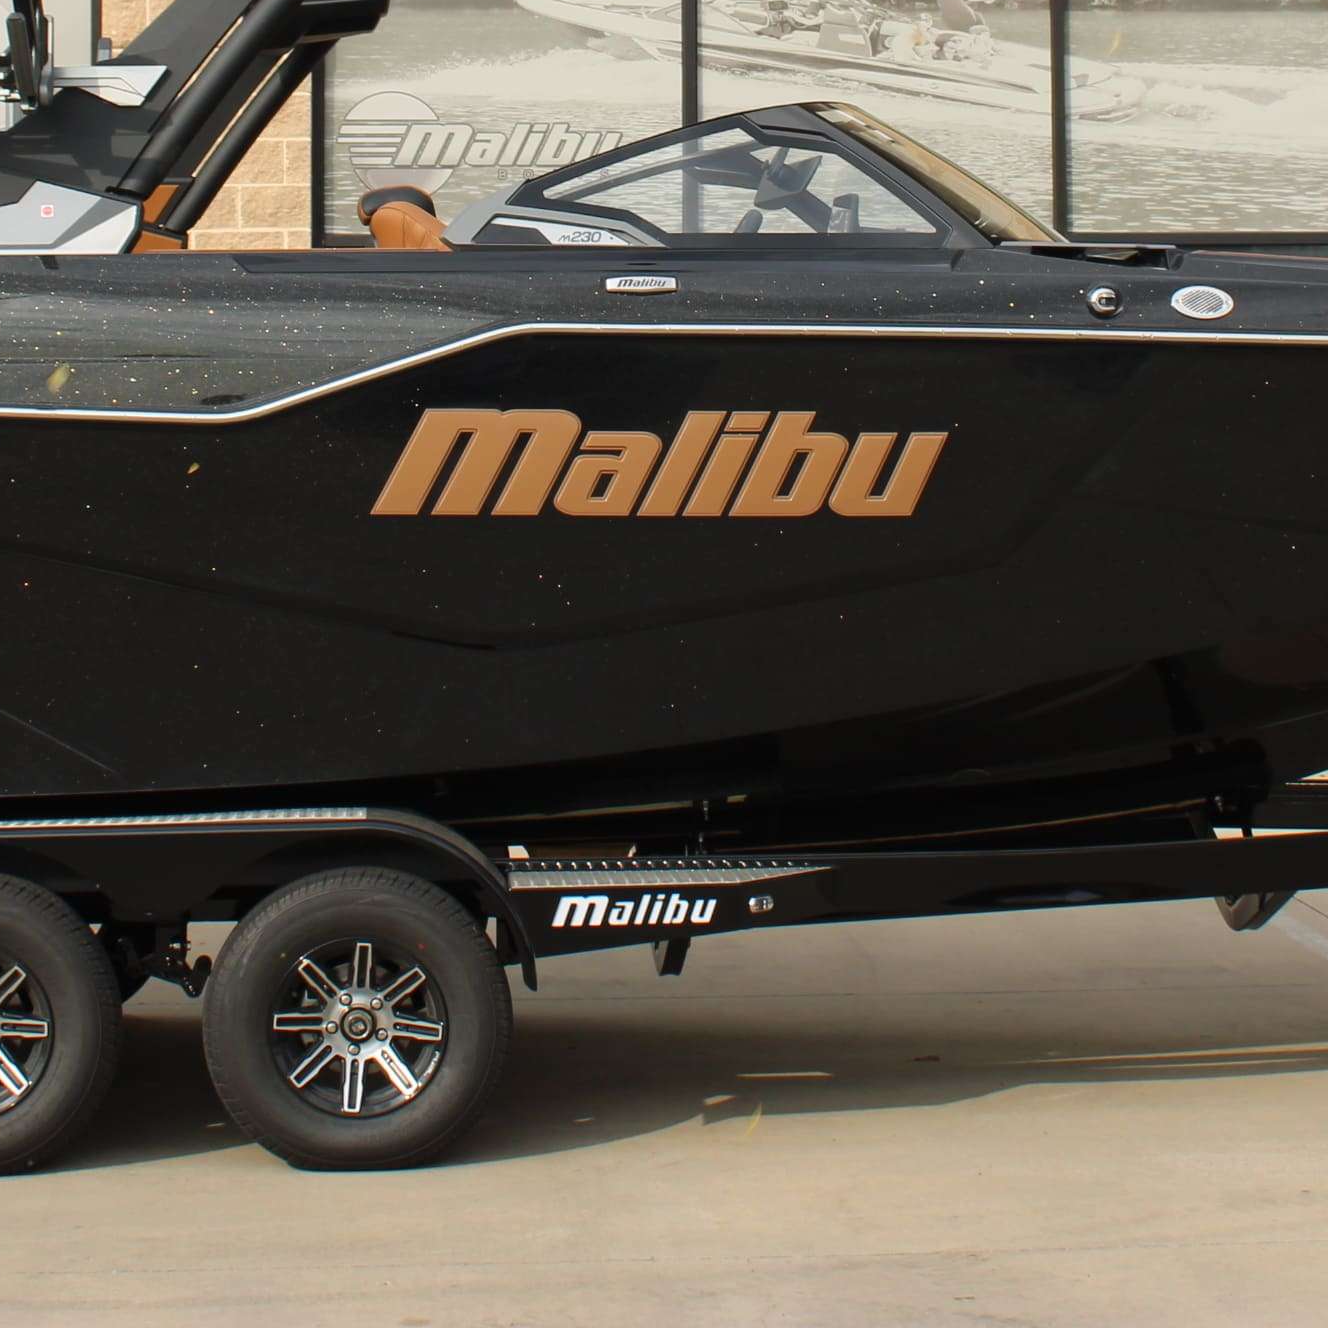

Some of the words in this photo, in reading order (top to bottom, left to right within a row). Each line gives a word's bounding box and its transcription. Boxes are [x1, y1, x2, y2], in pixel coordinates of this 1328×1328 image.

[391, 122, 623, 167] Malibu
[617, 278, 666, 287] Malibu
[371, 408, 949, 516] Malibu
[551, 893, 717, 927] Malibu
